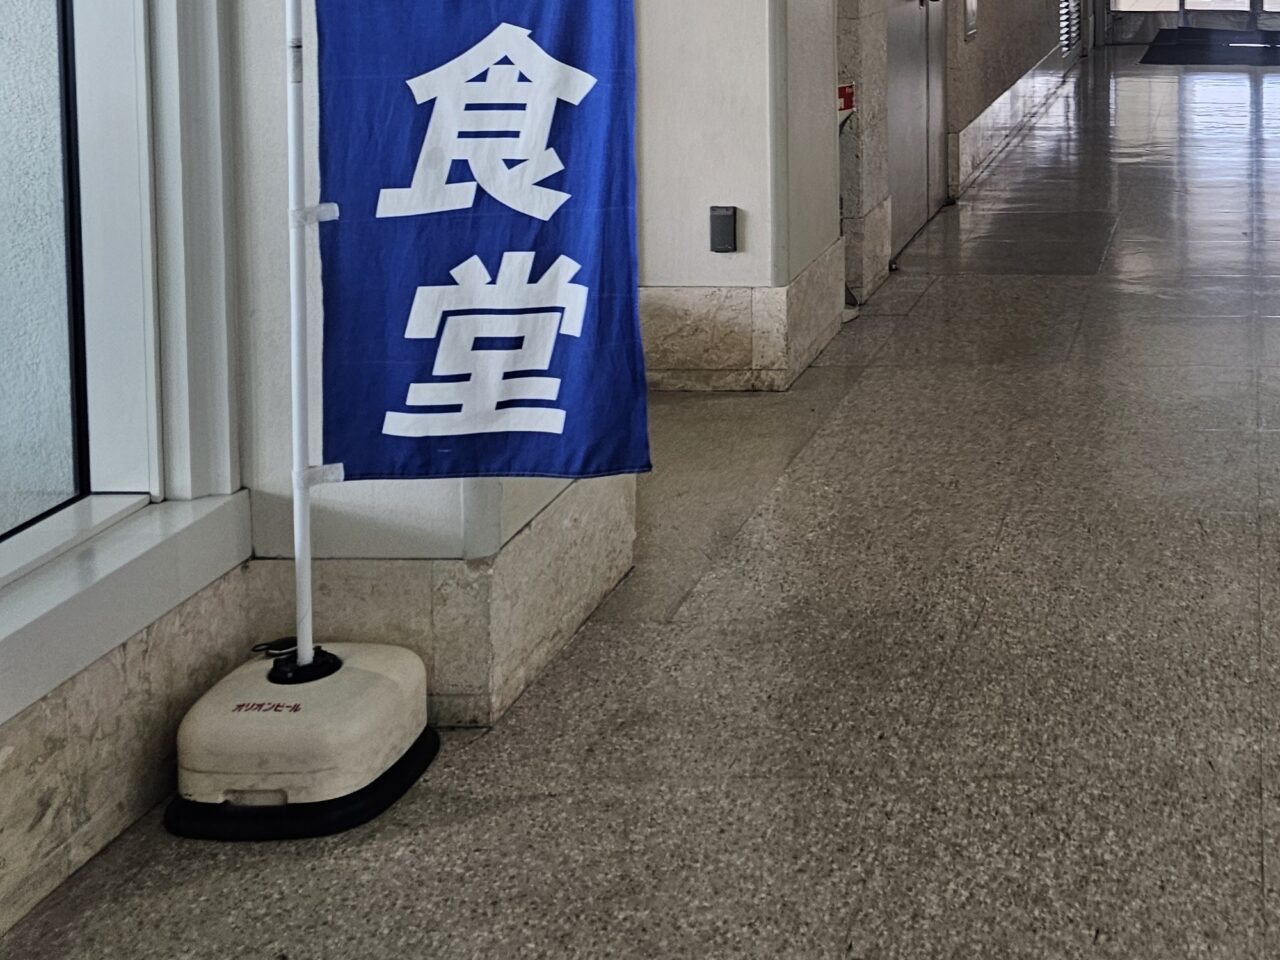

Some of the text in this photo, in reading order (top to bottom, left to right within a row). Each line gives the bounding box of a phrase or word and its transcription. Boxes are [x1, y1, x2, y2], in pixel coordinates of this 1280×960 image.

[231, 702, 303, 713] オリオンビール
